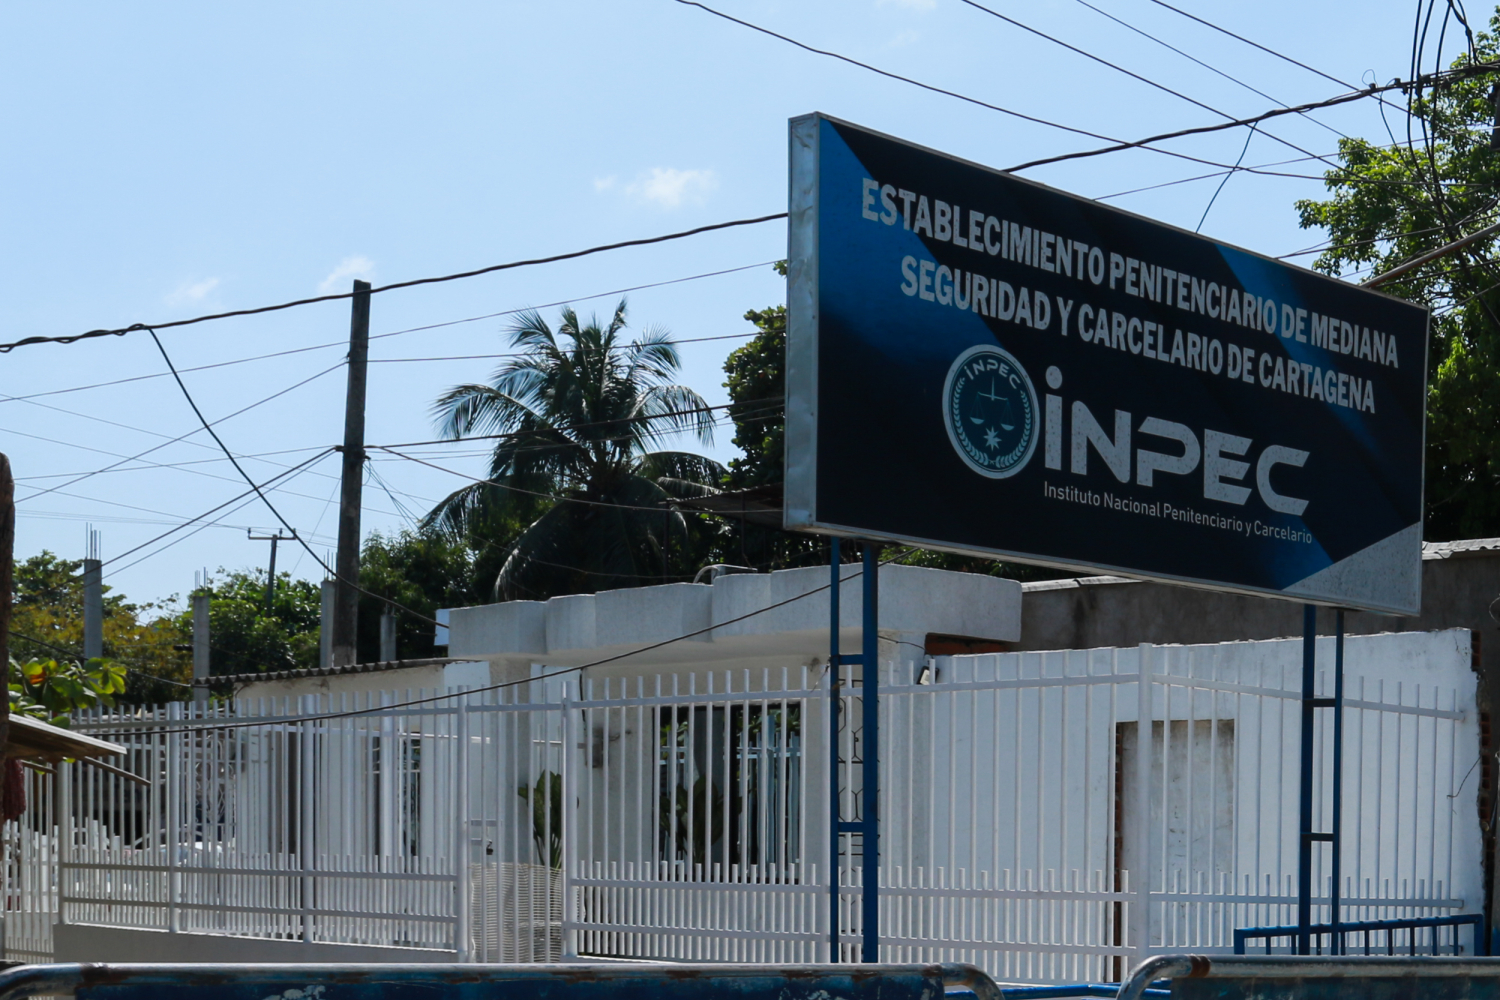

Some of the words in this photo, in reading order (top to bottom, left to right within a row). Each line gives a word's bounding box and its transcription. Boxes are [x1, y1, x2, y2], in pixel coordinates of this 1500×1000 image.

[862, 177, 1105, 285] ESTABLECIMIENTO
[1110, 252, 1277, 334] PENITENCIARIO
[1281, 303, 1307, 343] DE
[1311, 312, 1399, 369] MEDIANA
[901, 255, 1051, 330] SEGURIDAD
[1056, 296, 1074, 336] Y
[1078, 303, 1222, 375] CARCELARIO
[1227, 343, 1255, 384] DE
[1258, 352, 1376, 414] CARTAGENA
[1044, 481, 1101, 506] Instituto
[1104, 493, 1161, 518] Nacional
[1163, 504, 1243, 532] Penitenciario
[1245, 522, 1252, 537] y
[1254, 521, 1312, 544] Carcelario
